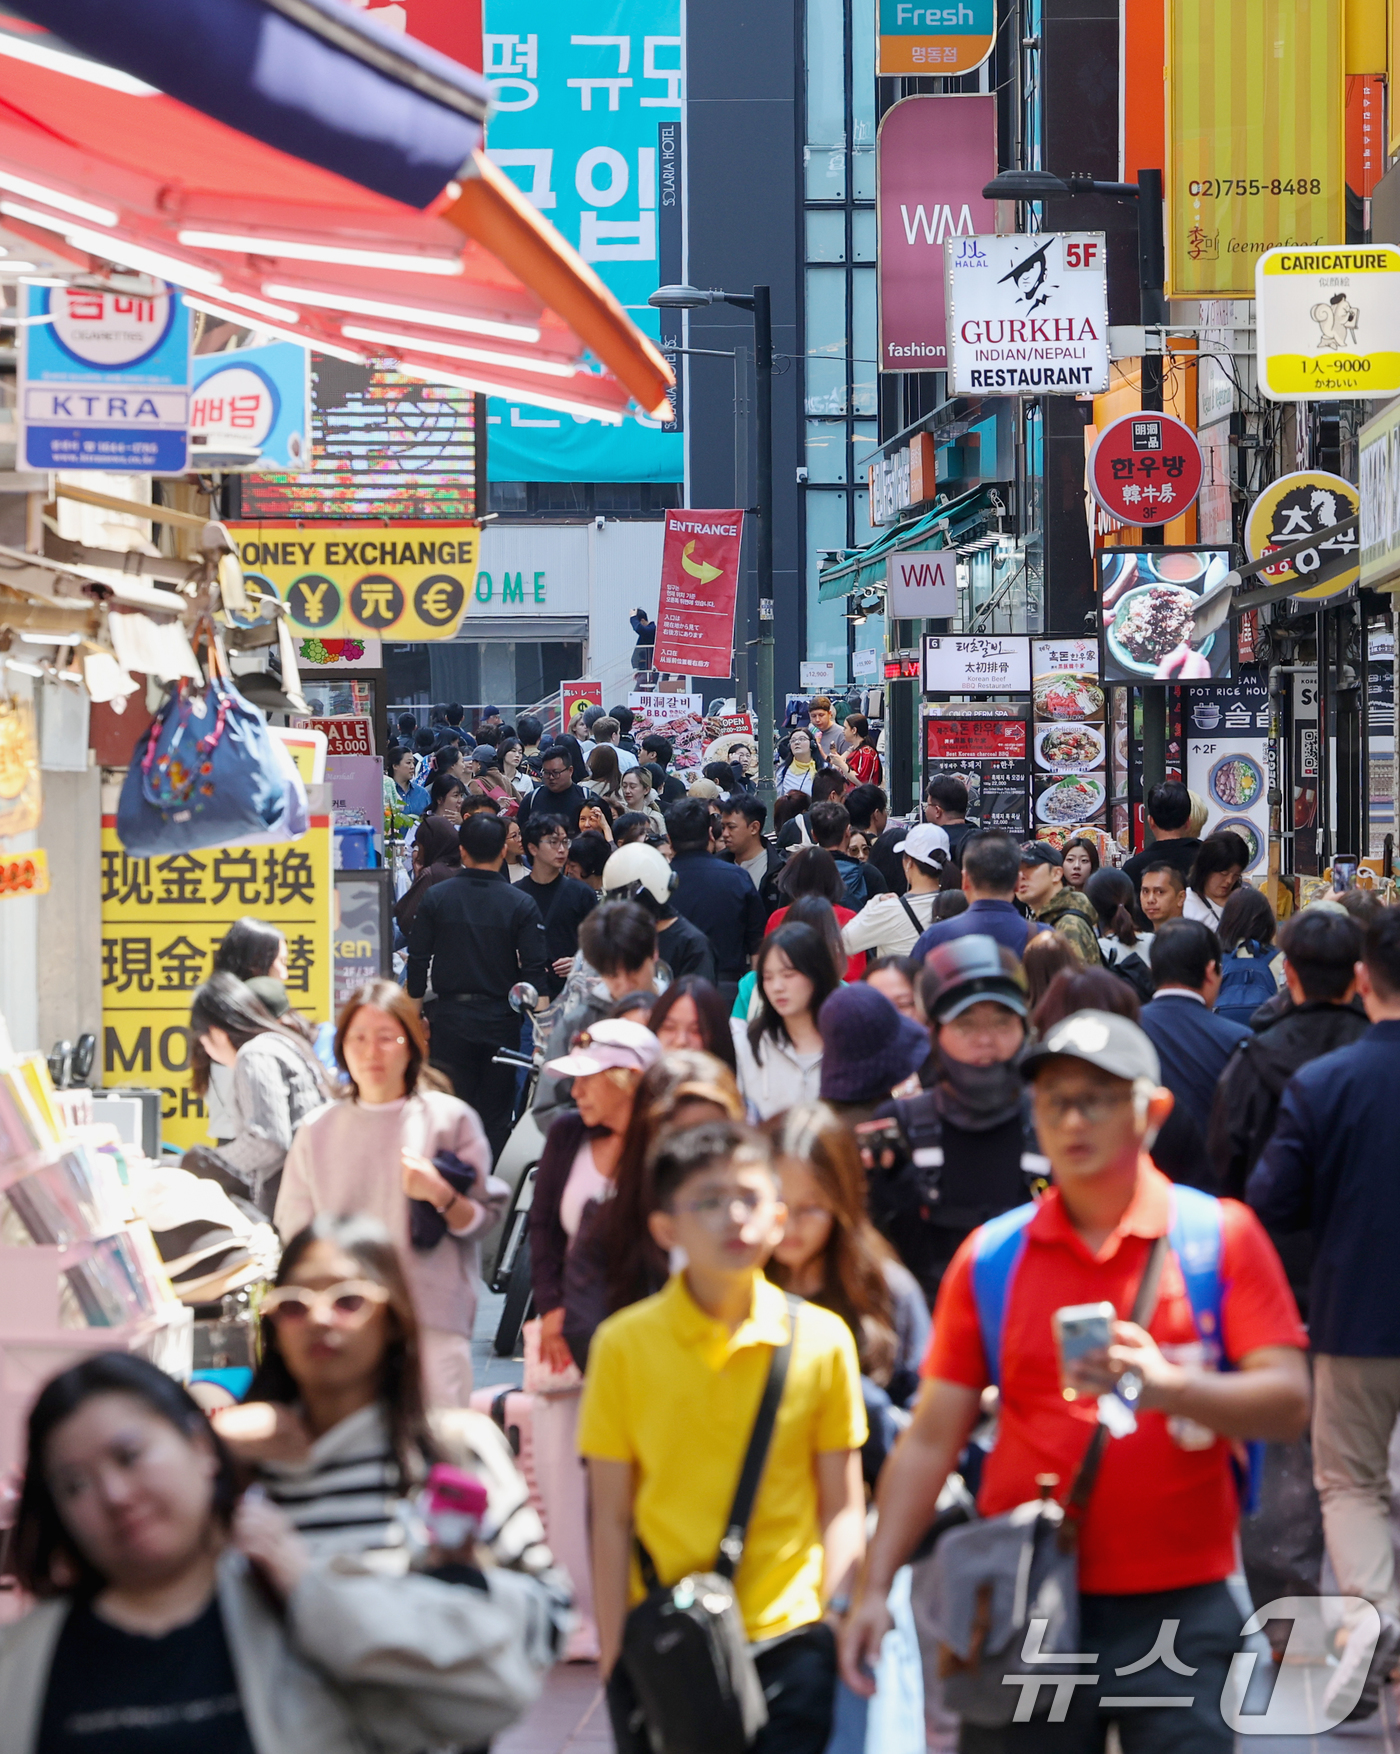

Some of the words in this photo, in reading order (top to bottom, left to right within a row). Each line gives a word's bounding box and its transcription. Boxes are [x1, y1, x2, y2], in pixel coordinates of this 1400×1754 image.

[897, 4, 974, 26] Fresh
[911, 46, 958, 64] 명동점
[661, 125, 675, 160] HOTEL
[662, 161, 676, 207] SOLARIA
[1188, 177, 1322, 199] 02)755-8488
[900, 203, 975, 244] WM
[957, 240, 987, 259] حلال
[1066, 243, 1098, 268] 5F
[955, 260, 989, 268] HALAL
[1280, 254, 1388, 271] CARICATURE
[960, 317, 1099, 345] GURKHA
[887, 341, 947, 358] fashion
[974, 346, 1087, 362] INDIAN/NEPALI
[970, 366, 1094, 388] RESTAURANT
[1314, 378, 1358, 389] かわいい
[52, 395, 161, 420] KTRA
[1135, 423, 1159, 436] 明洞
[1135, 436, 1160, 449] 一品
[1110, 455, 1186, 480] 한우방
[1121, 482, 1177, 506] 韓牛房
[1142, 506, 1158, 519] 3F
[668, 519, 738, 537] ENTRANCE
[236, 542, 316, 566] ONEY
[325, 541, 473, 565] EXCHANGE
[900, 563, 946, 588] WM
[664, 613, 681, 622] 入口は
[660, 648, 678, 657] 入口在
[930, 639, 939, 649] 6
[955, 638, 1003, 659] 태초갈비
[1049, 650, 1069, 662] 흑돈
[964, 661, 1010, 673] 太初排骨
[961, 682, 976, 690] BBQ
[1189, 687, 1211, 697] POT
[1216, 687, 1241, 696] RICE
[640, 695, 690, 709] 明洞갈비
[721, 717, 745, 728] OPEN
[314, 724, 367, 741] SALE
[1202, 745, 1217, 754] 2F
[959, 760, 982, 769] 흑돼지
[101, 848, 315, 905] 现金兑换
